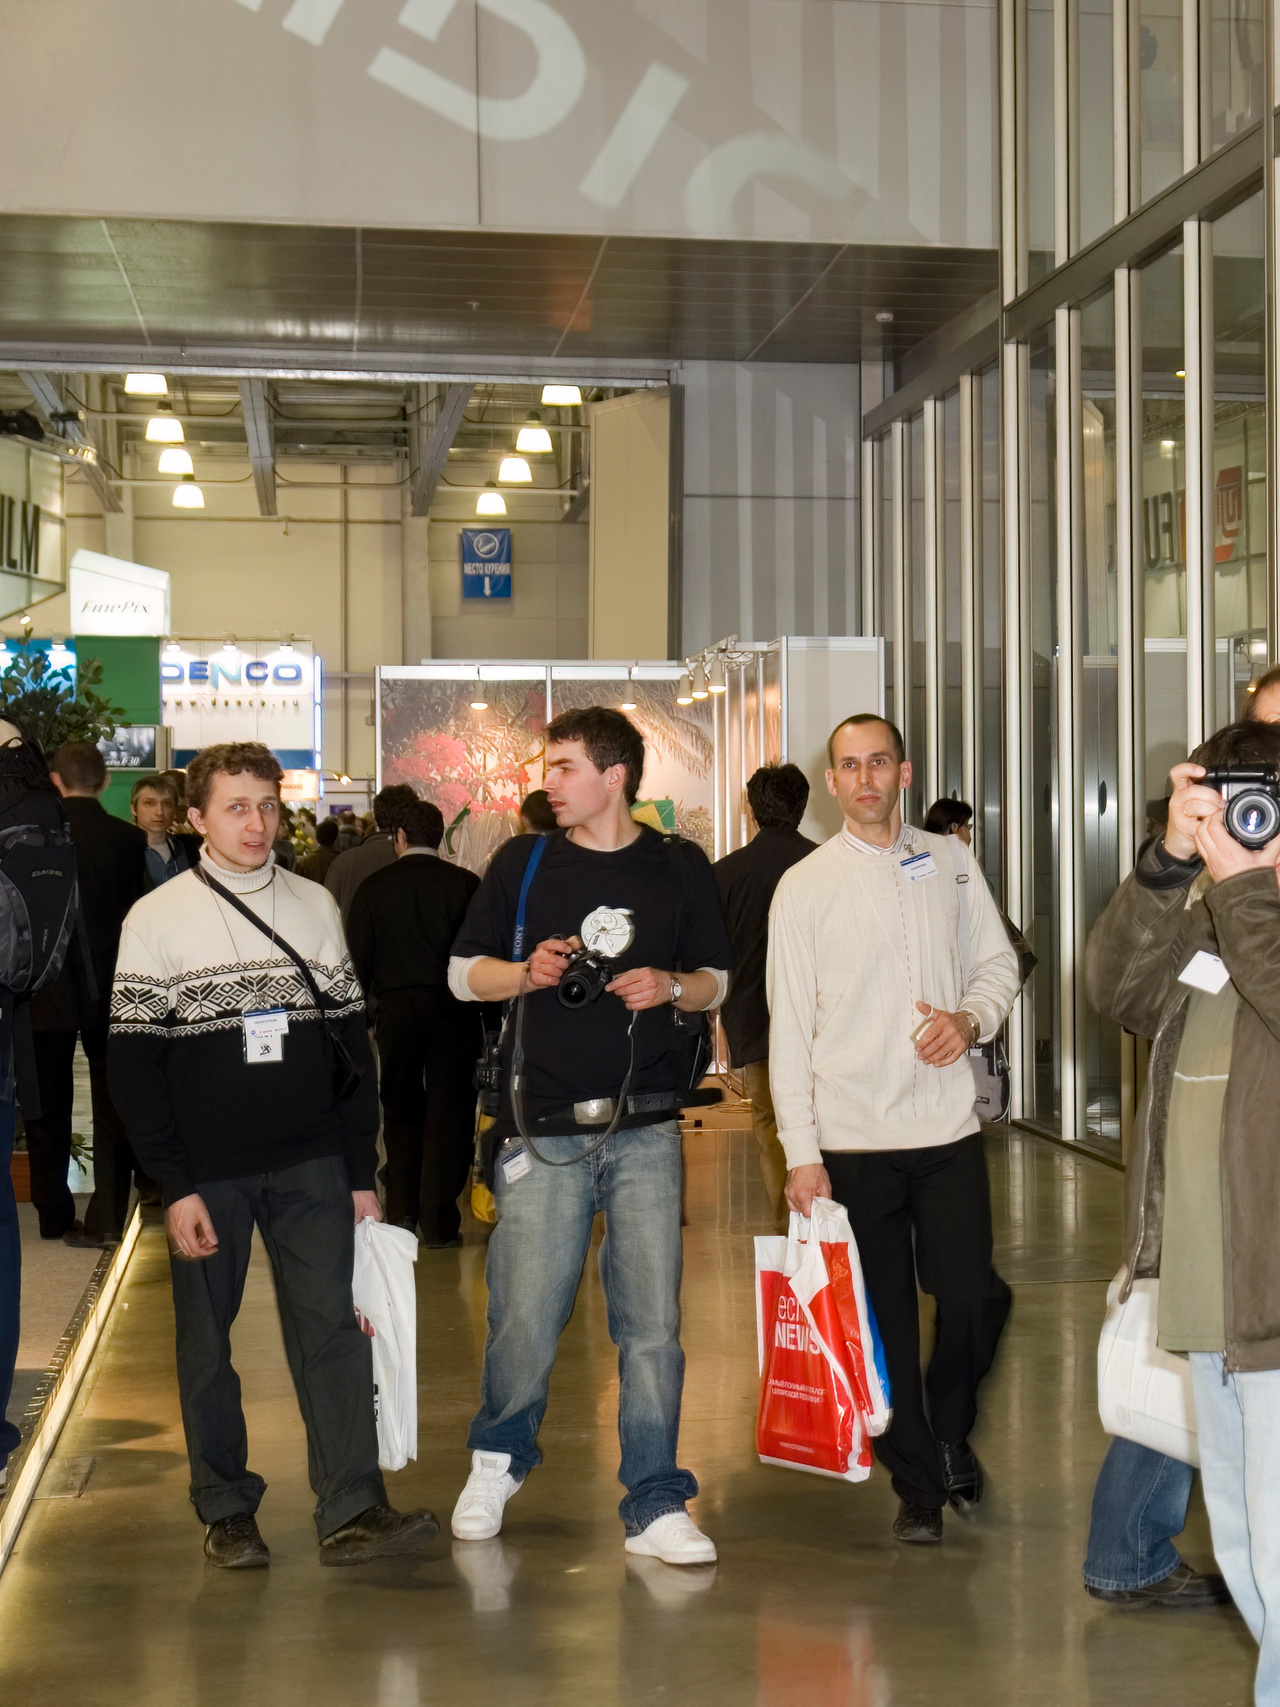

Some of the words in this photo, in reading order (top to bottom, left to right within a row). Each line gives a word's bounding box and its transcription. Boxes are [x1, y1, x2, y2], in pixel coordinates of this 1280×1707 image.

[80, 600, 150, 614] FinePix
[162, 661, 302, 689] DENCO
[775, 1321, 820, 1354] NEWS
